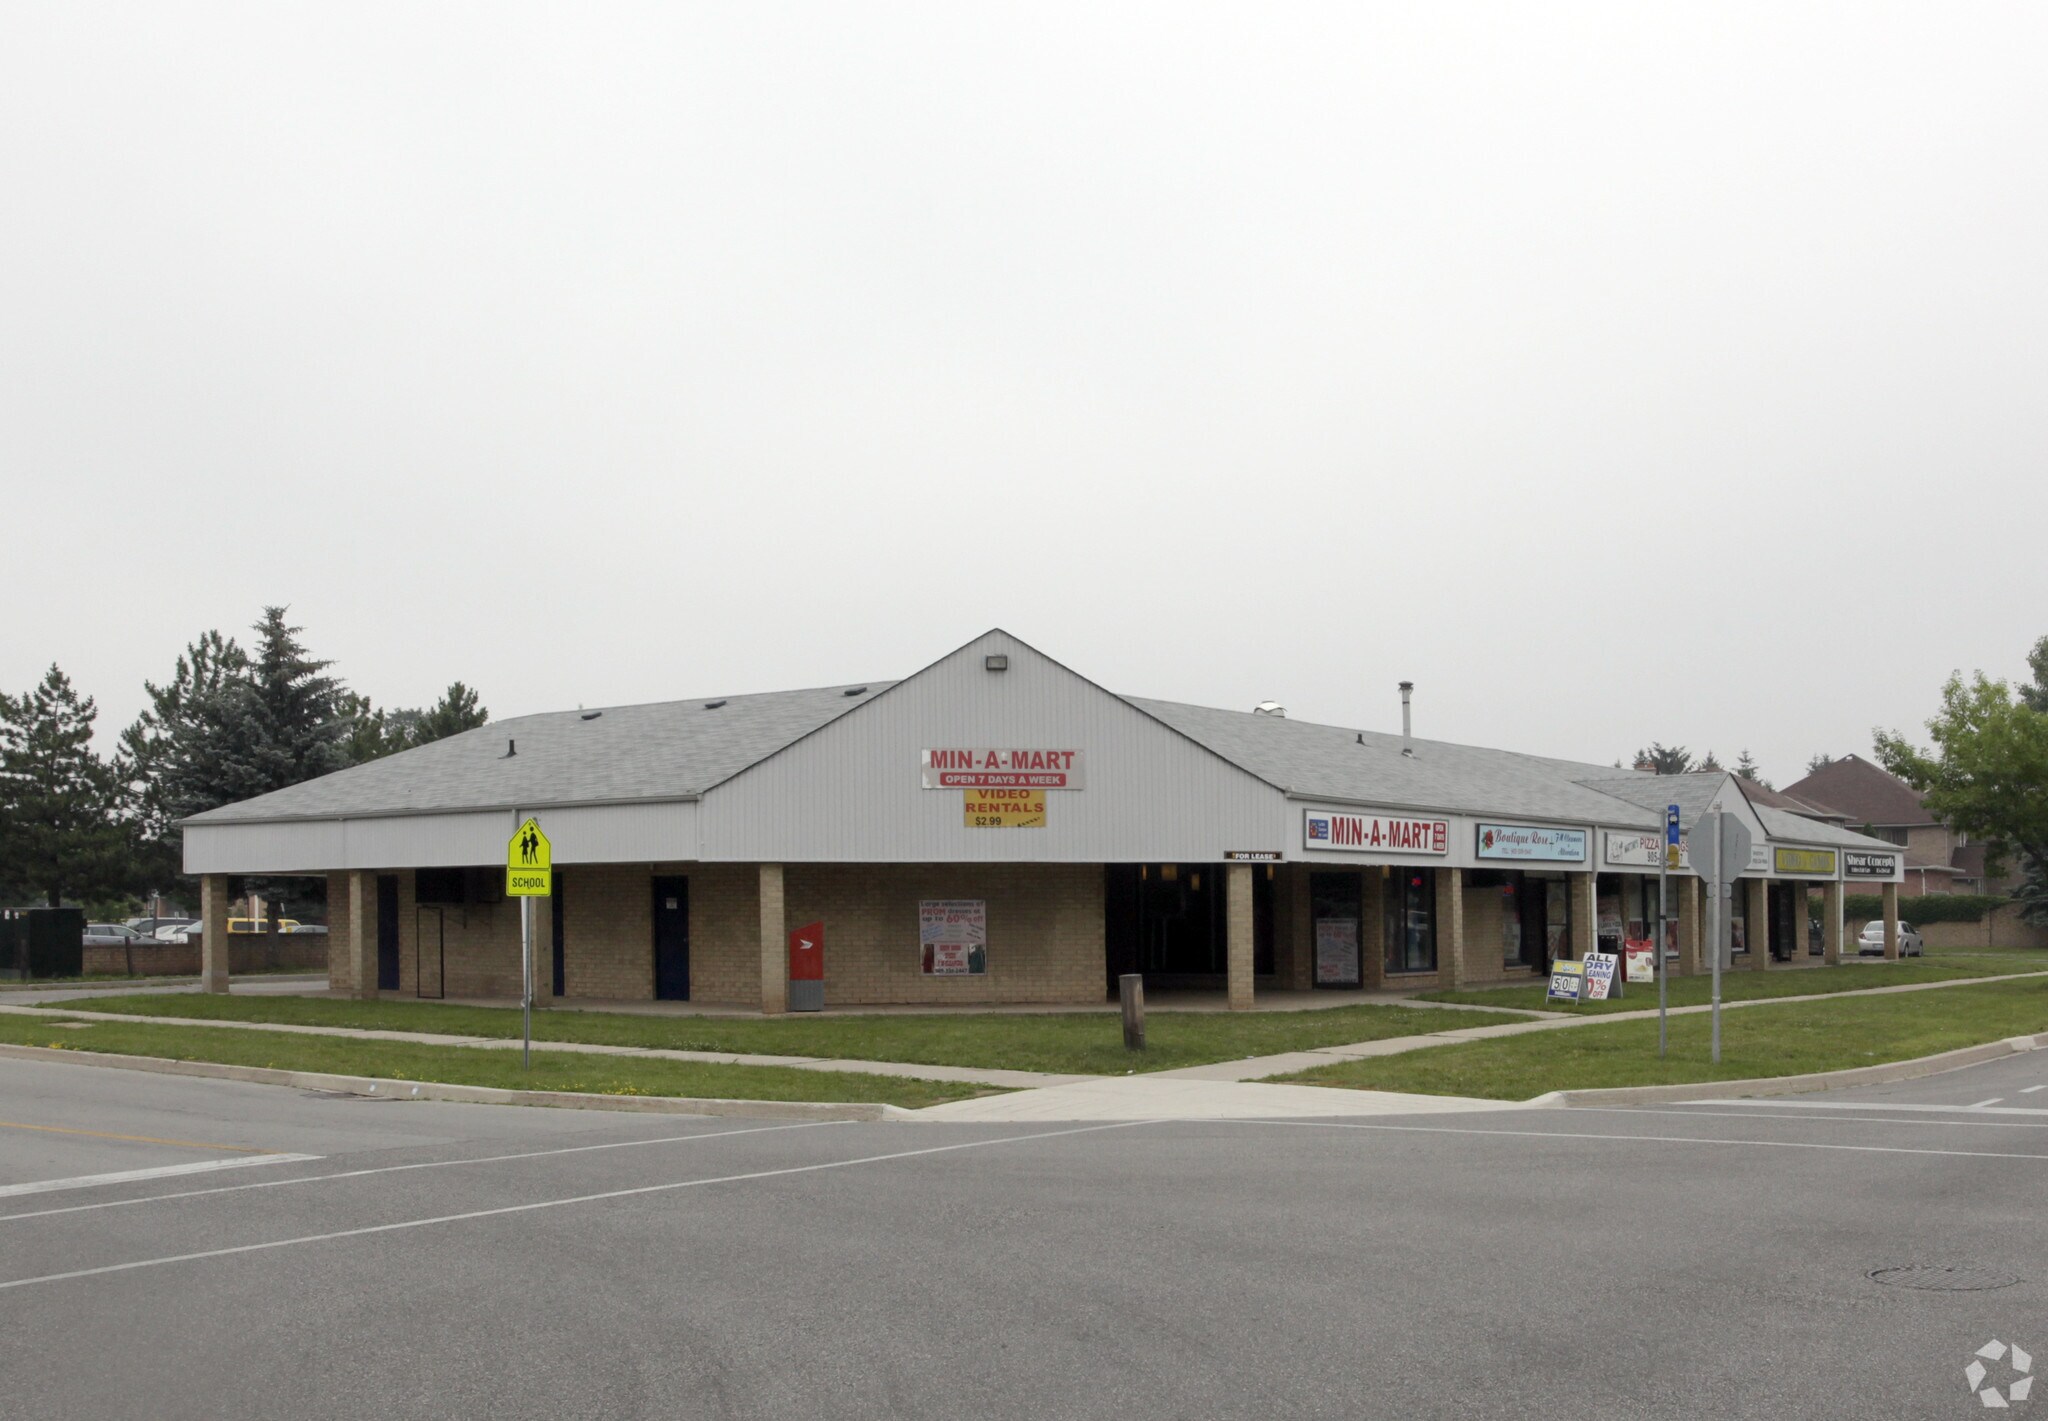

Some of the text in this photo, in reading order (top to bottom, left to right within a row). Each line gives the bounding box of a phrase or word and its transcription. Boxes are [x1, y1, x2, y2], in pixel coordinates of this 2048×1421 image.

[930, 750, 1075, 770] MIN-A-MART
[945, 775, 1060, 785] OPEN 7 DAYS A WEEK
[978, 789, 1030, 799] VIDEO
[965, 803, 1044, 813] RENTALS
[975, 816, 1002, 826] $2.99
[1331, 816, 1431, 849] MIN-A-MART
[1494, 829, 1549, 846] Boutique Rose
[1640, 837, 1660, 850] PIZZA
[512, 877, 545, 888] SCHOOL
[1587, 954, 1612, 963] ALL
[1586, 962, 1613, 971] DRY
[1588, 970, 1611, 979] EANING
[1554, 978, 1569, 990] 50
